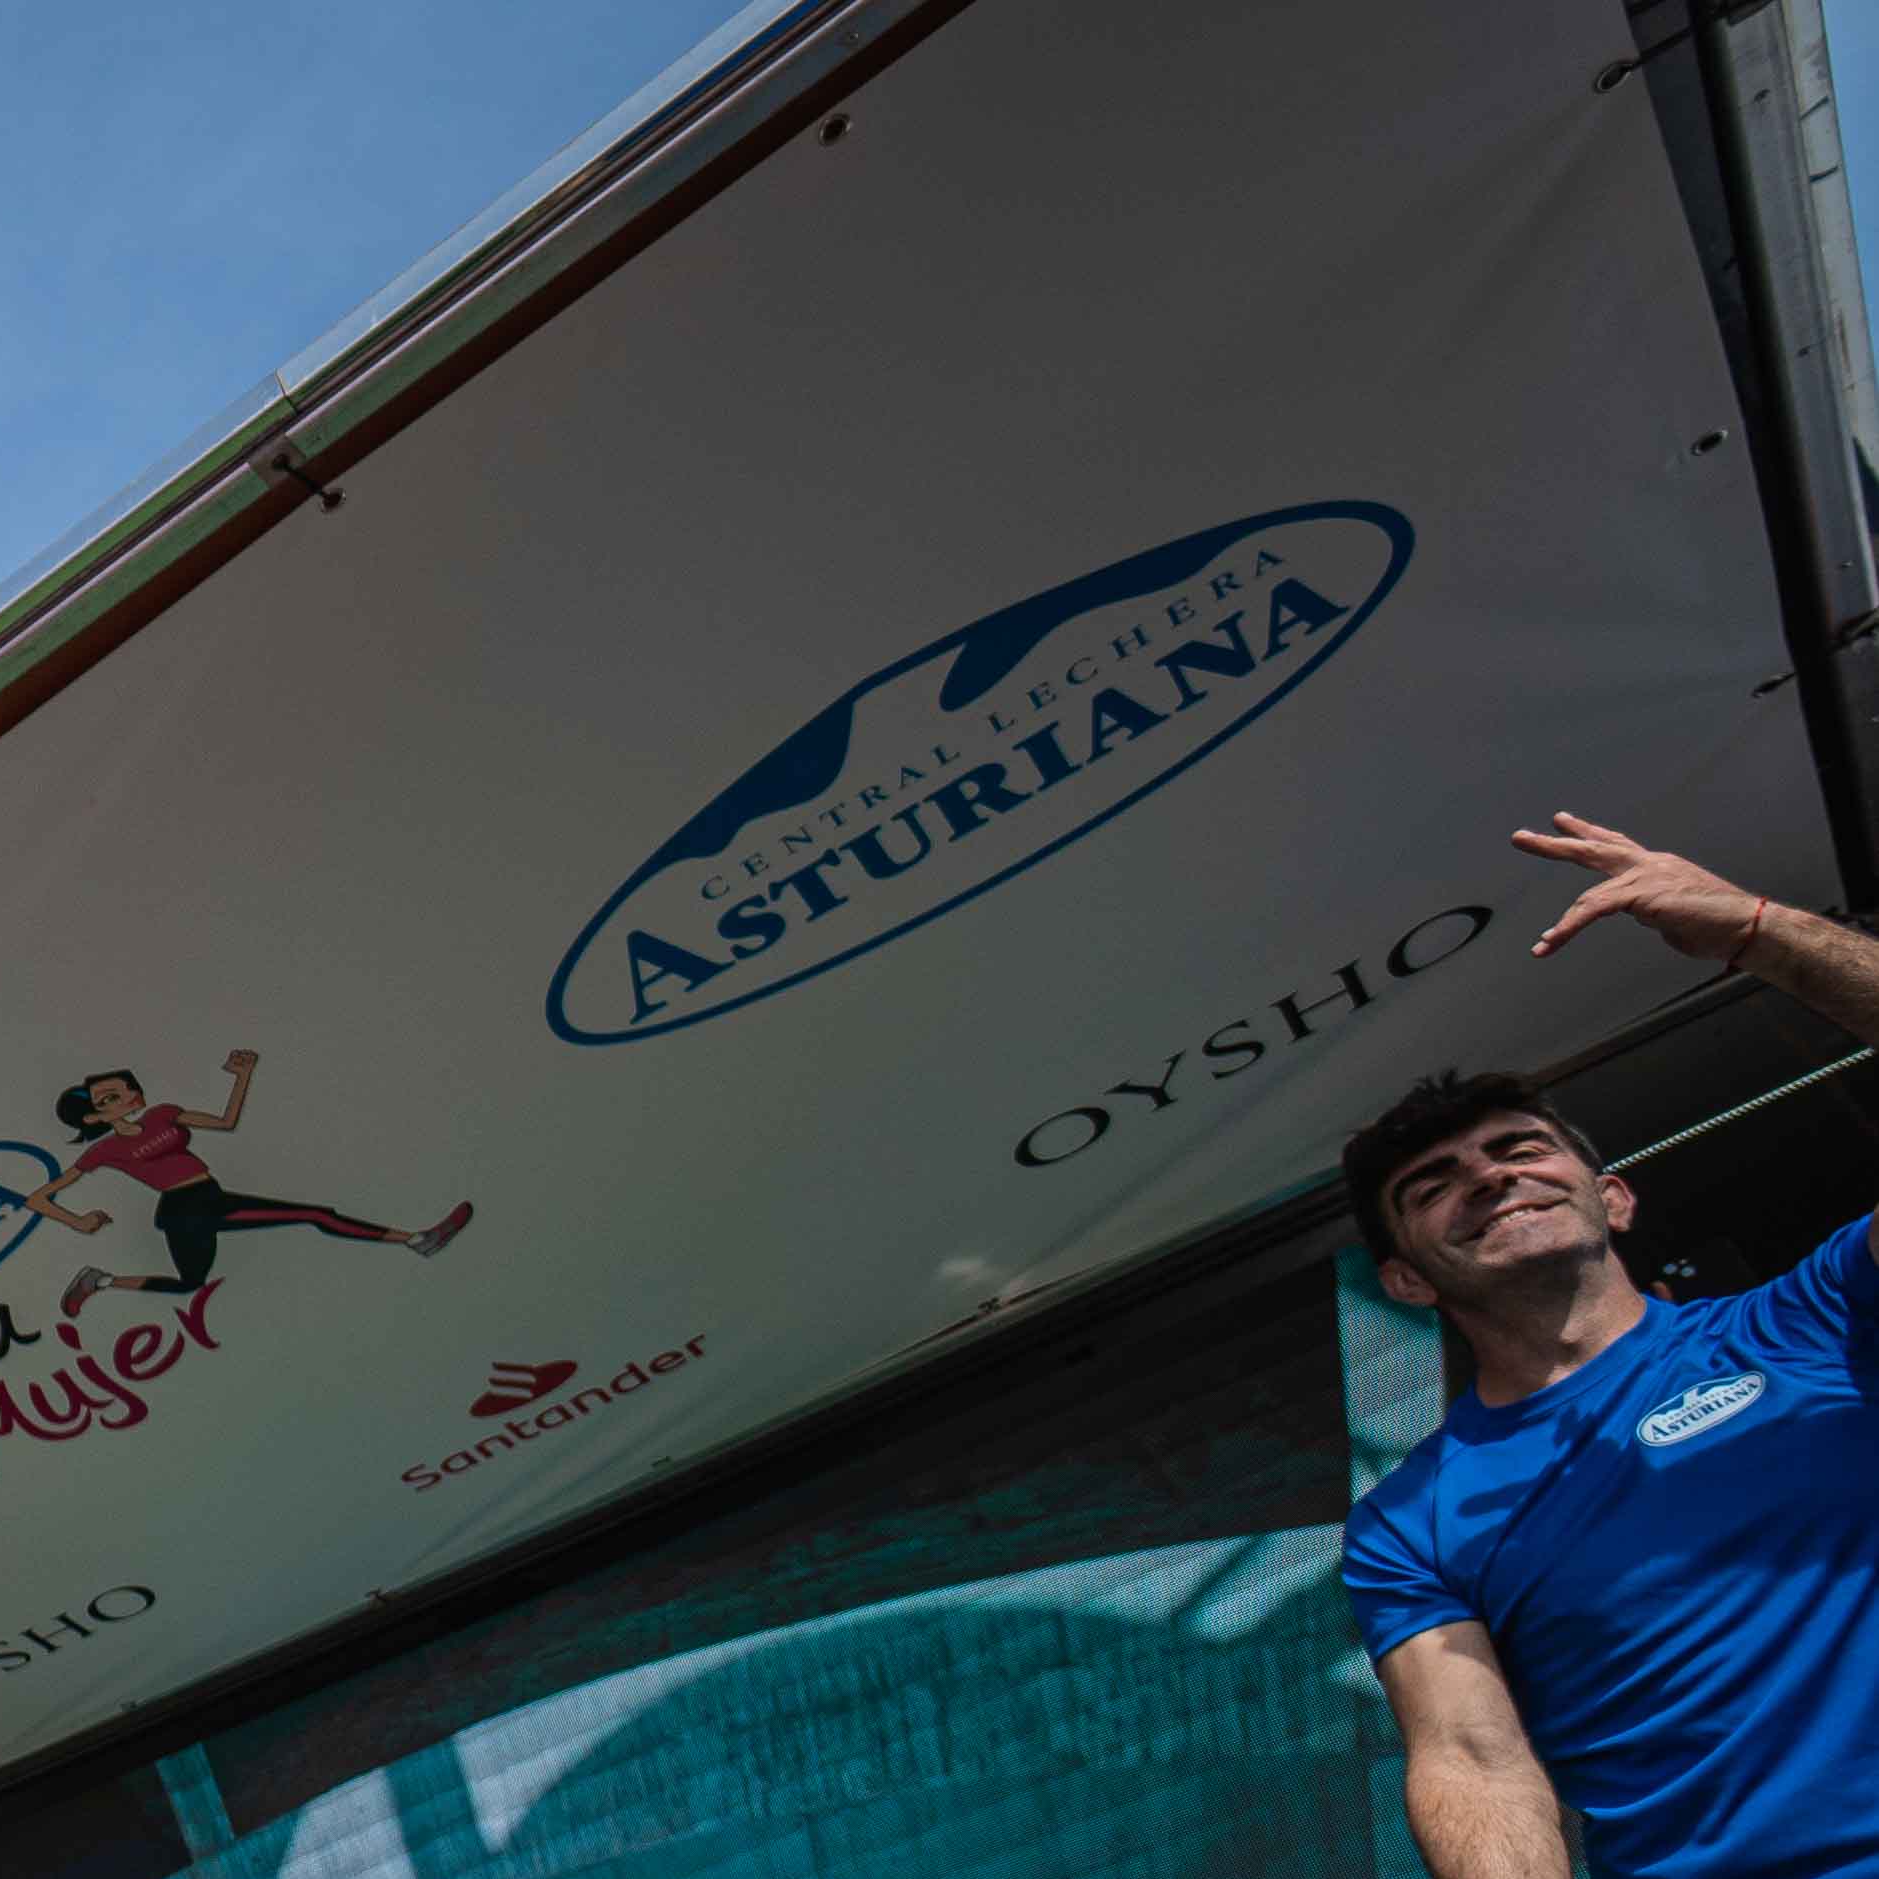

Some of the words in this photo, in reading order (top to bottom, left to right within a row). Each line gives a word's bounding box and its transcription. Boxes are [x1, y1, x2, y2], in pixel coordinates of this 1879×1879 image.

[626, 577, 1351, 1025] ASTURIANA
[700, 743, 961, 901] CENTRAL
[986, 548, 1286, 735] LECHERA
[1013, 905, 1494, 1168] OYSHO
[400, 1333, 706, 1493] Santander
